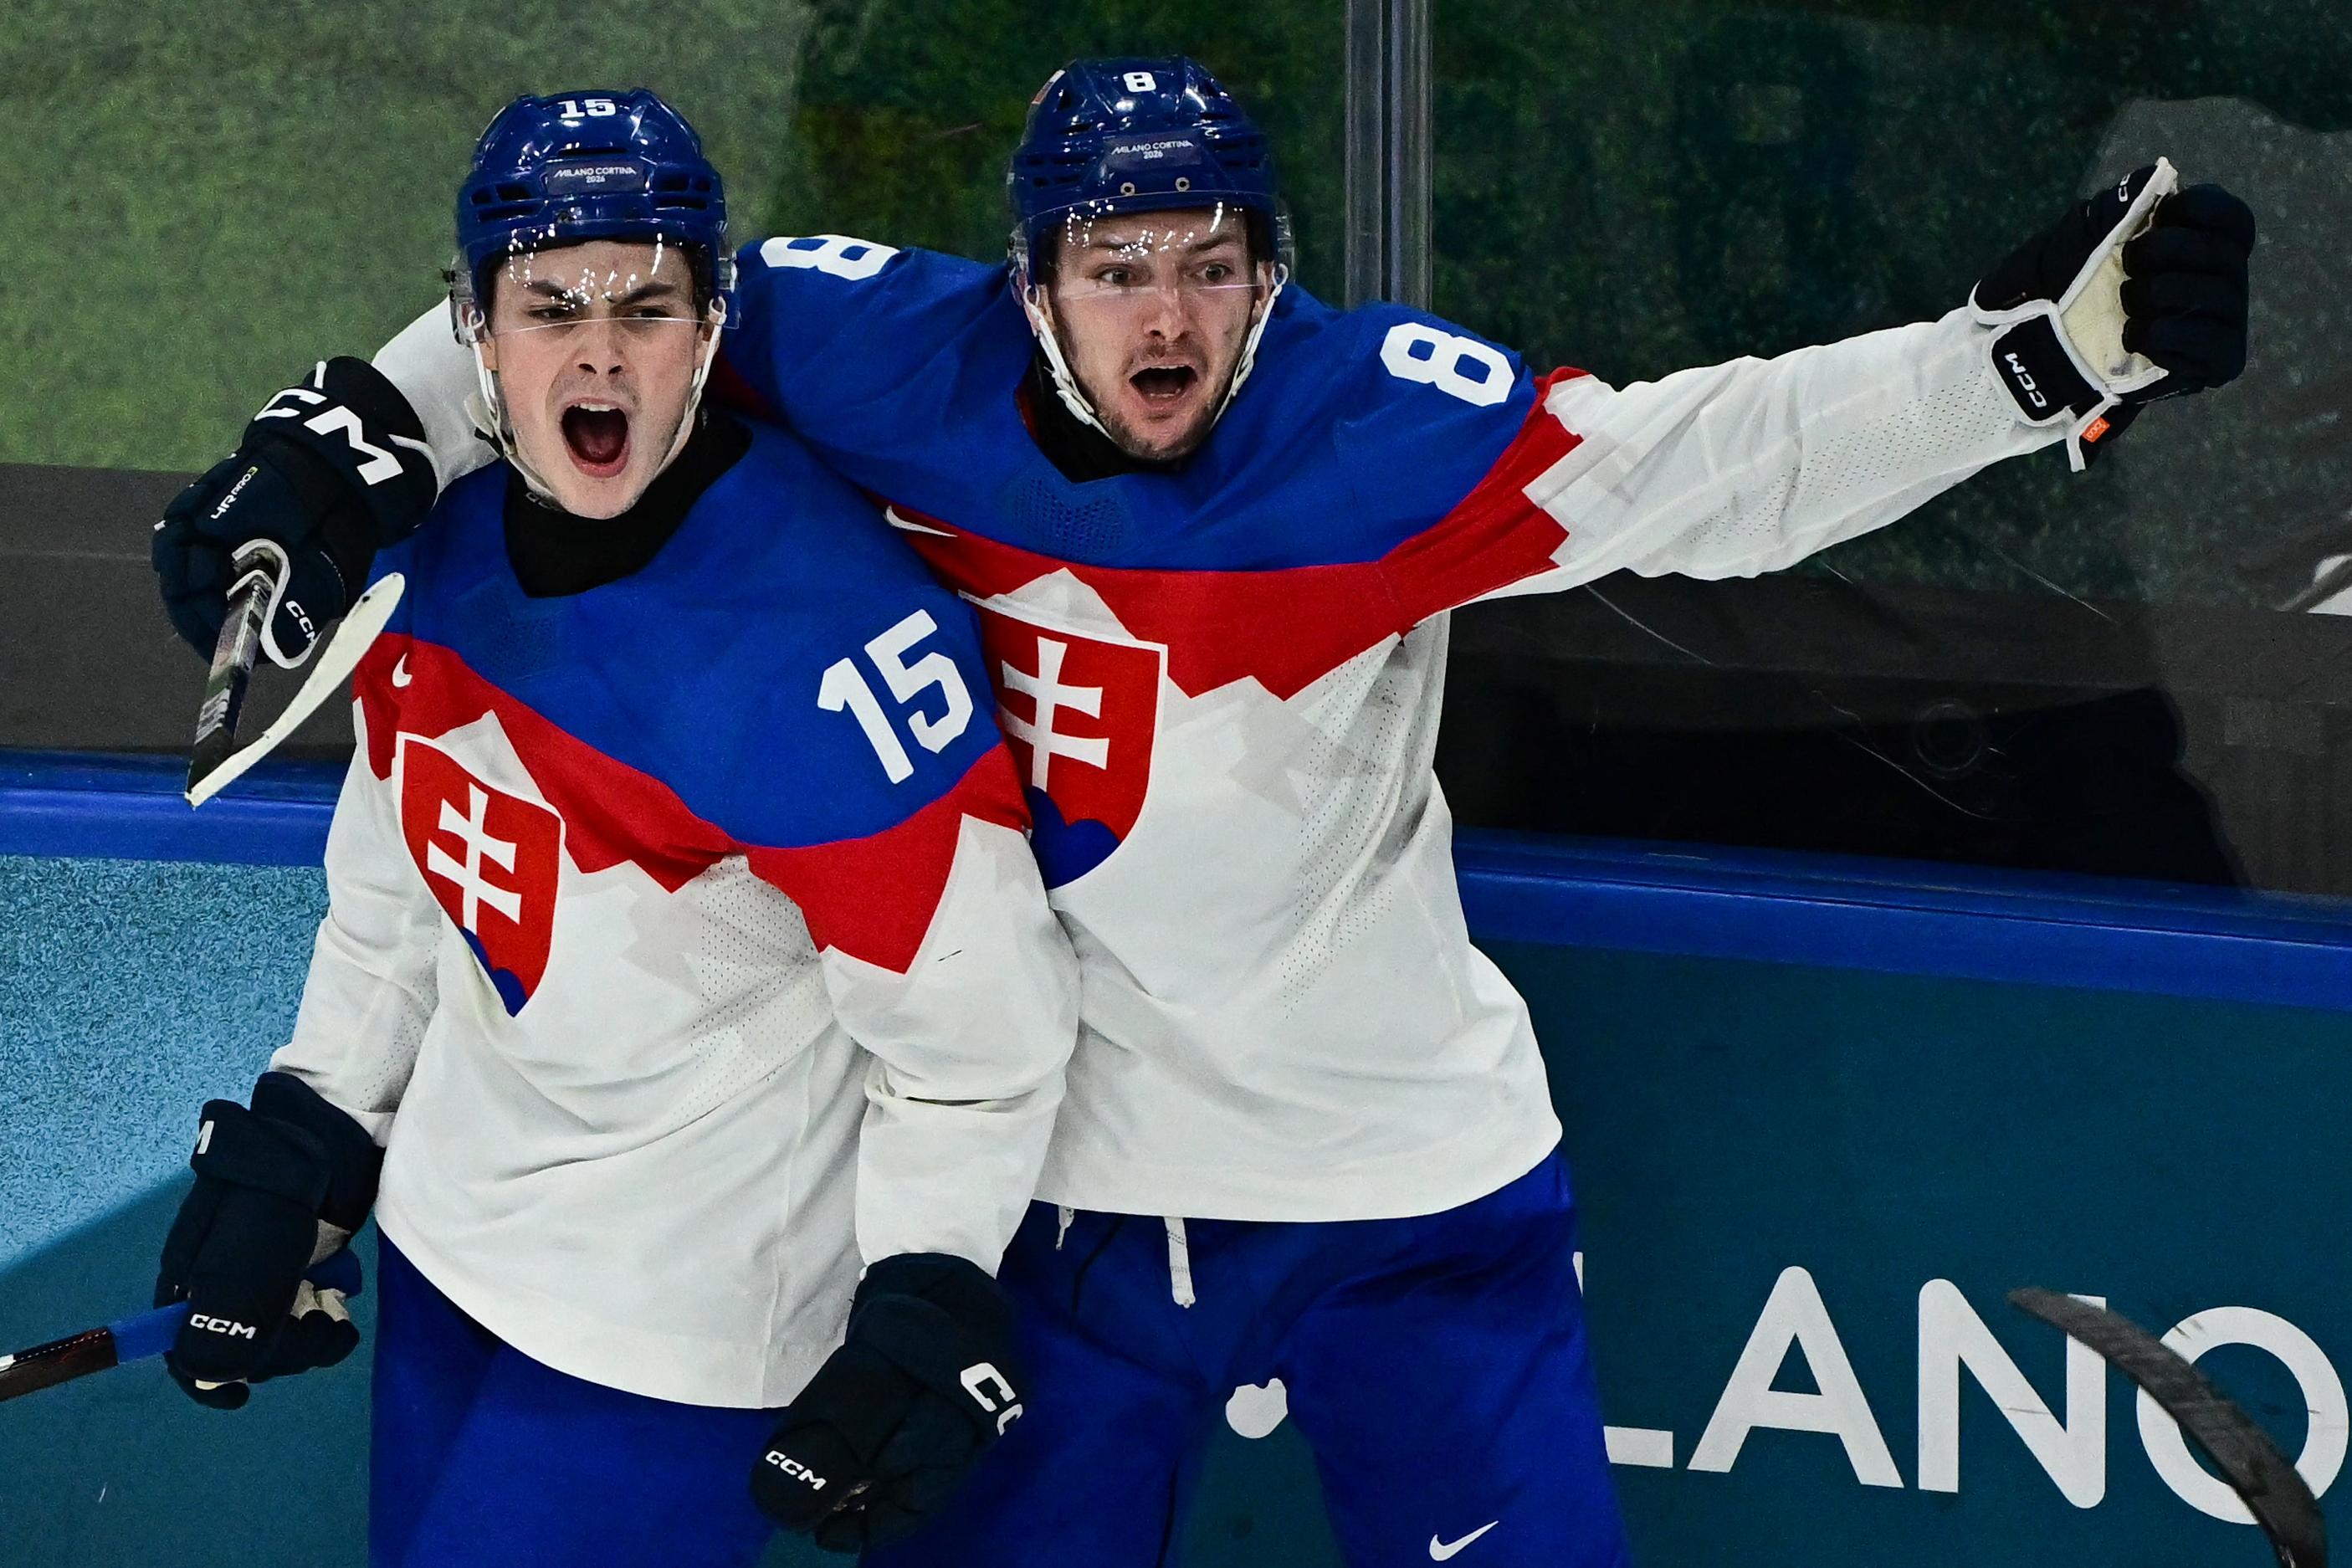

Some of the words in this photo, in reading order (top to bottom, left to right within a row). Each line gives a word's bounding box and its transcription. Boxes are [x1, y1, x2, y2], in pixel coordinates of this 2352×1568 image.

[1123, 71, 1157, 93] 8
[558, 99, 617, 119] 15
[1110, 143, 1150, 156] MILANO
[1152, 140, 1194, 150] CORTINA
[1143, 150, 1164, 160] 2026
[553, 167, 594, 178] MILANO
[595, 167, 637, 176] CORTINA
[586, 175, 606, 184] 2026
[760, 234, 900, 281] 8
[1380, 322, 1515, 407] 8
[2004, 352, 2047, 408] CCM
[817, 609, 973, 784] 15
[189, 1313, 256, 1340] CCM
[766, 1450, 827, 1491] CCM
